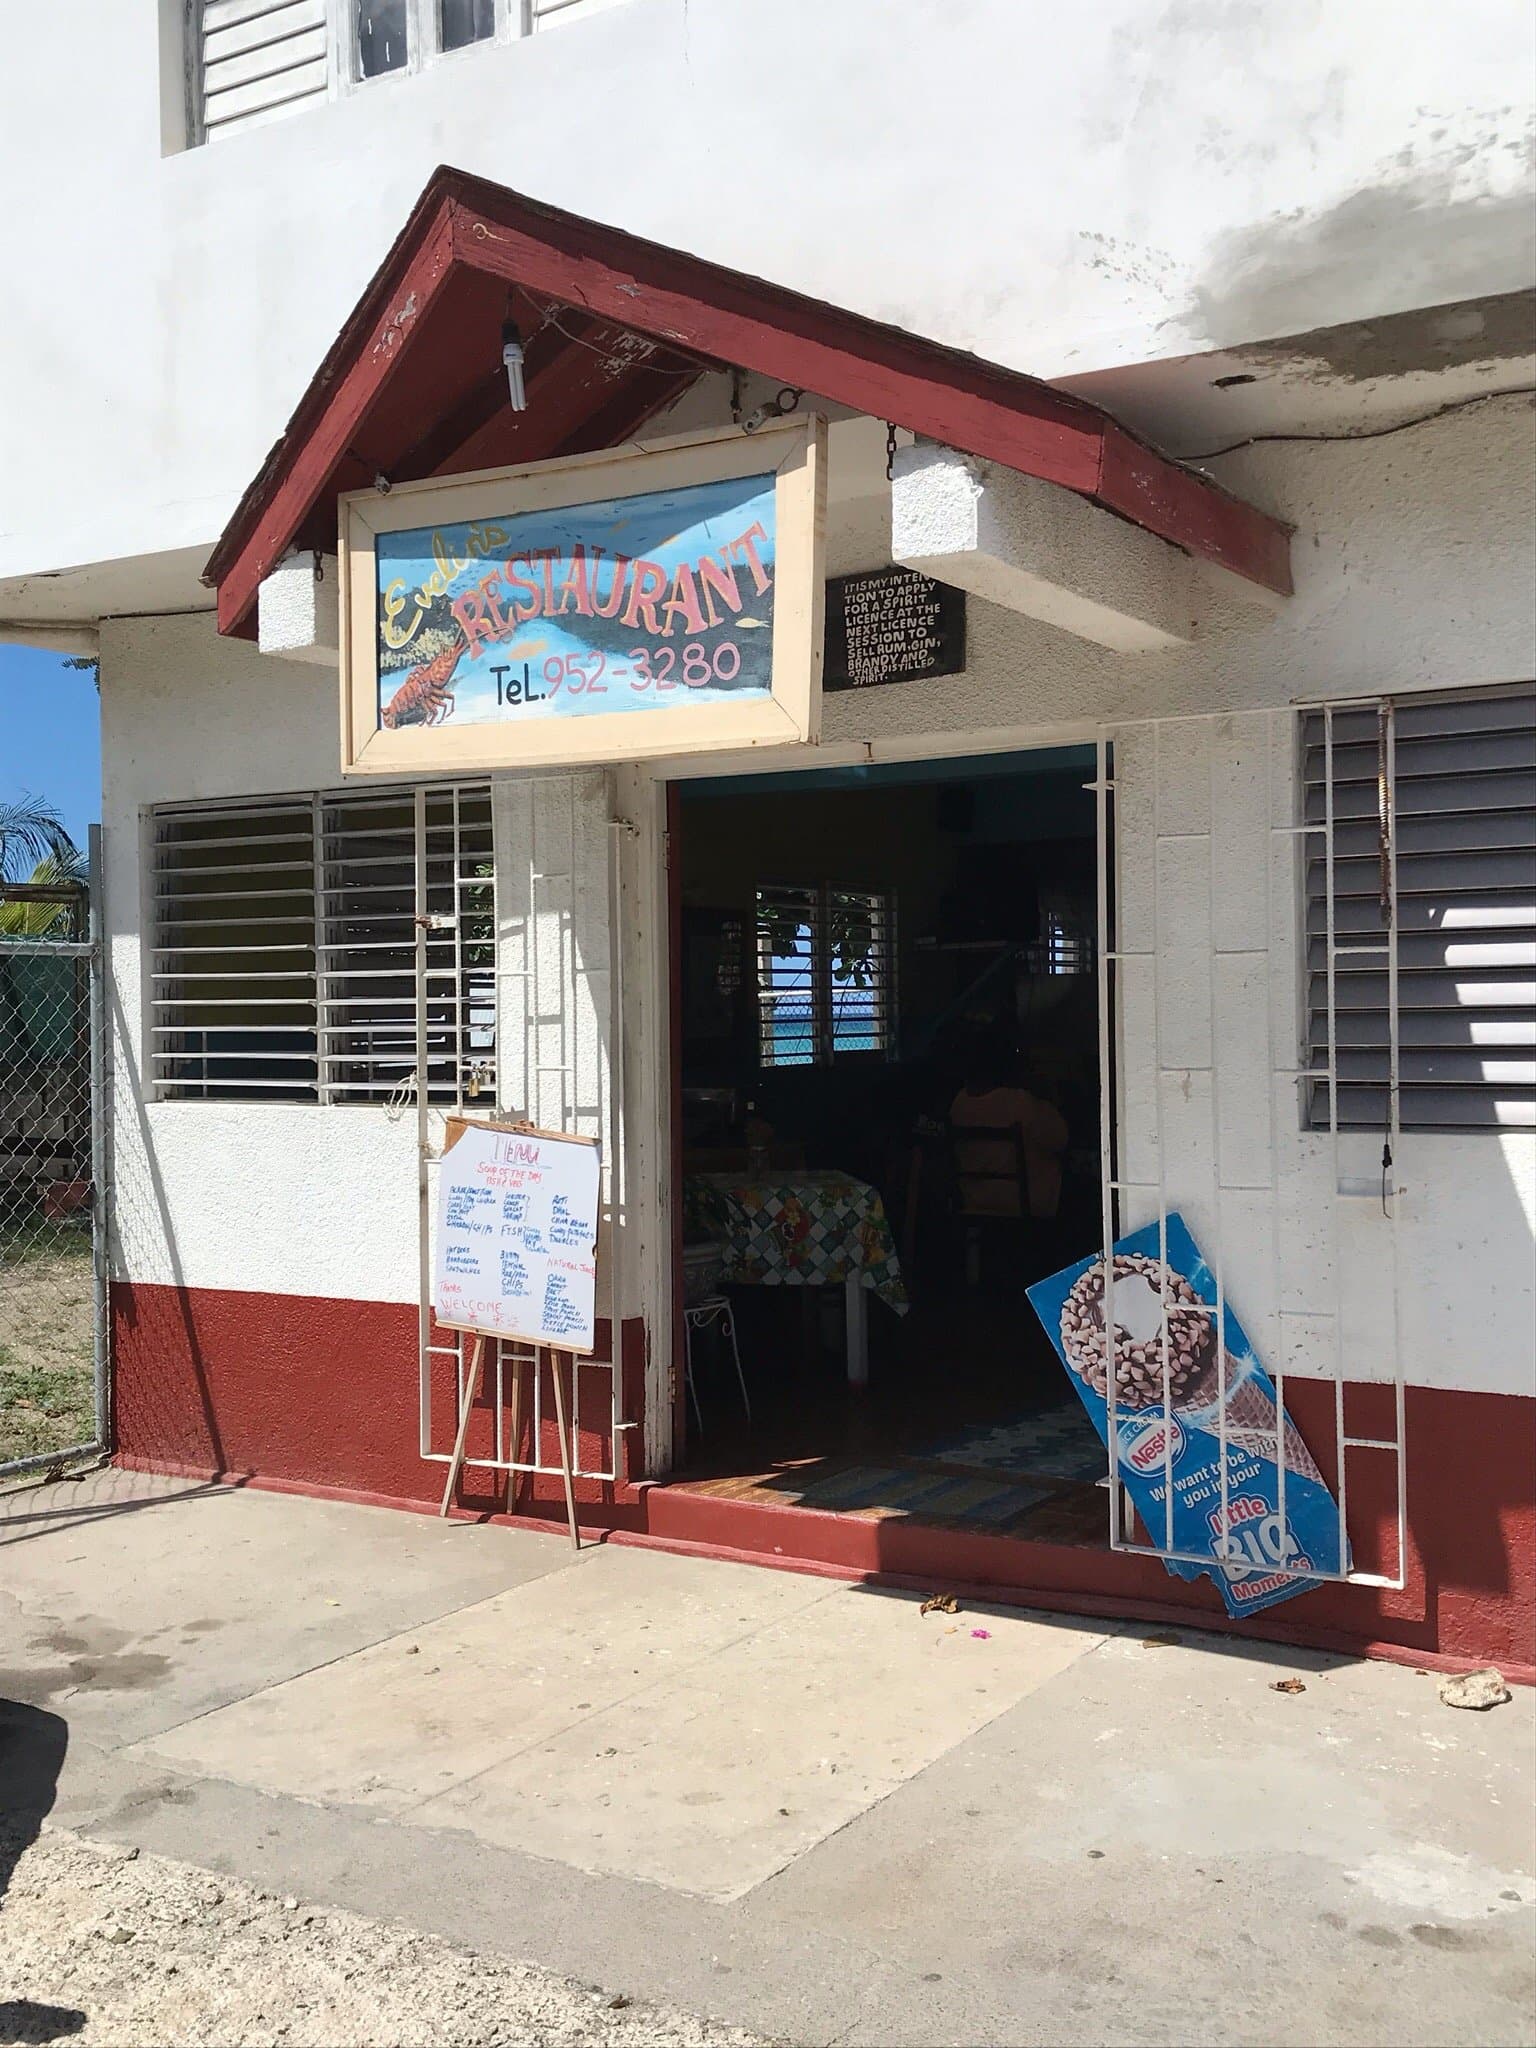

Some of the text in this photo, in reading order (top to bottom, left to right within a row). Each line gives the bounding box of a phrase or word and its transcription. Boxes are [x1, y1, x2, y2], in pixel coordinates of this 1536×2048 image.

[450, 520, 774, 659] RESTAURANT
[844, 582, 936, 604] TION TO APPLY
[844, 595, 927, 616] FOR A SPIRIT
[846, 604, 941, 626] LICENCE AT THE
[846, 616, 935, 637] NEXT LICENCE
[847, 628, 927, 648] SESSION TO
[848, 647, 875, 659] SELL
[848, 650, 928, 670] BRANDY AND
[543, 641, 742, 699] 952-3280
[848, 657, 935, 677] OTHER DISTILLED
[440, 1297, 504, 1314] WELCOME
[1131, 1426, 1180, 1469] Neste
[1174, 1466, 1211, 1492] want
[1227, 1452, 1247, 1467] be
[1183, 1485, 1212, 1508] you
[1228, 1463, 1262, 1489] your
[1210, 1498, 1267, 1536] Lttle
[1213, 1514, 1298, 1582] BIG
